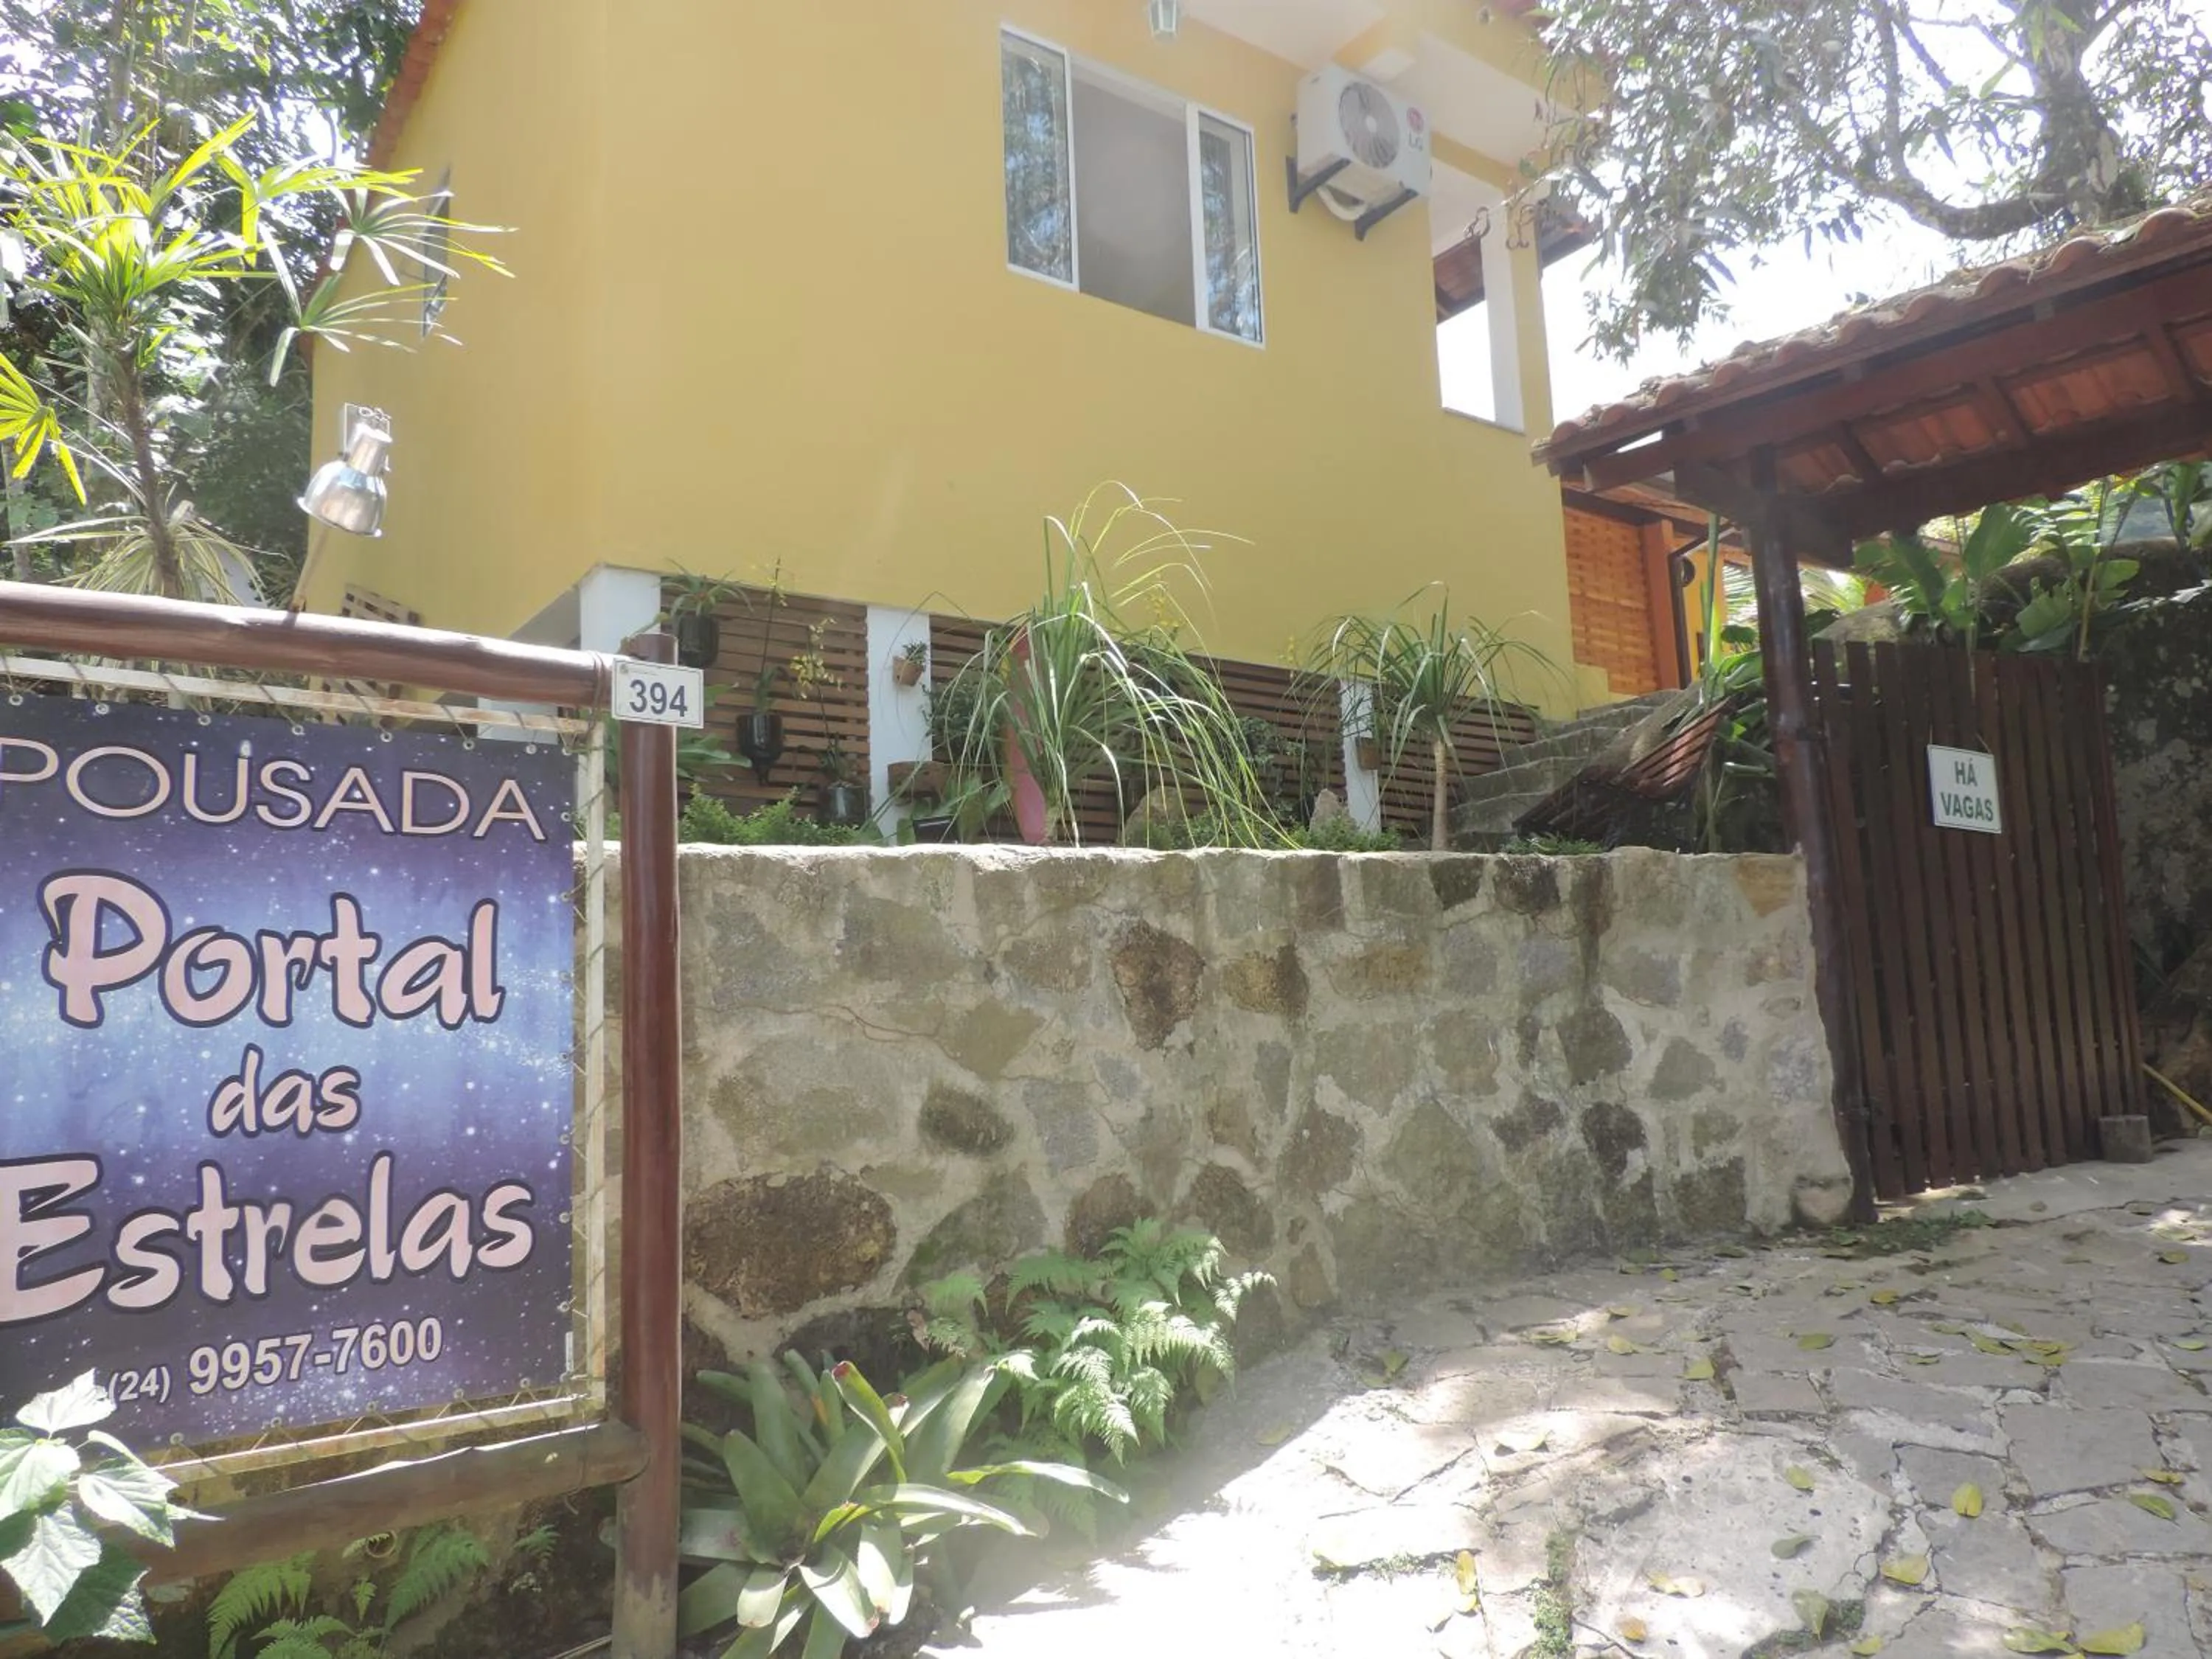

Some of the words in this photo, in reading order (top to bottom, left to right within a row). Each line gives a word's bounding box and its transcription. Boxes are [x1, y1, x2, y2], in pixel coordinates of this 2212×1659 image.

[629, 679, 688, 717] 394
[0, 737, 546, 840] POUSADA
[1940, 791, 1994, 822] VAGAS
[1954, 758, 1978, 787] HÁ
[39, 872, 505, 1029] Portal
[209, 1044, 361, 1137] das
[0, 1152, 534, 1322] Estrelas
[108, 1366, 171, 1404] (24)
[187, 1317, 443, 1396] 9957-7600
